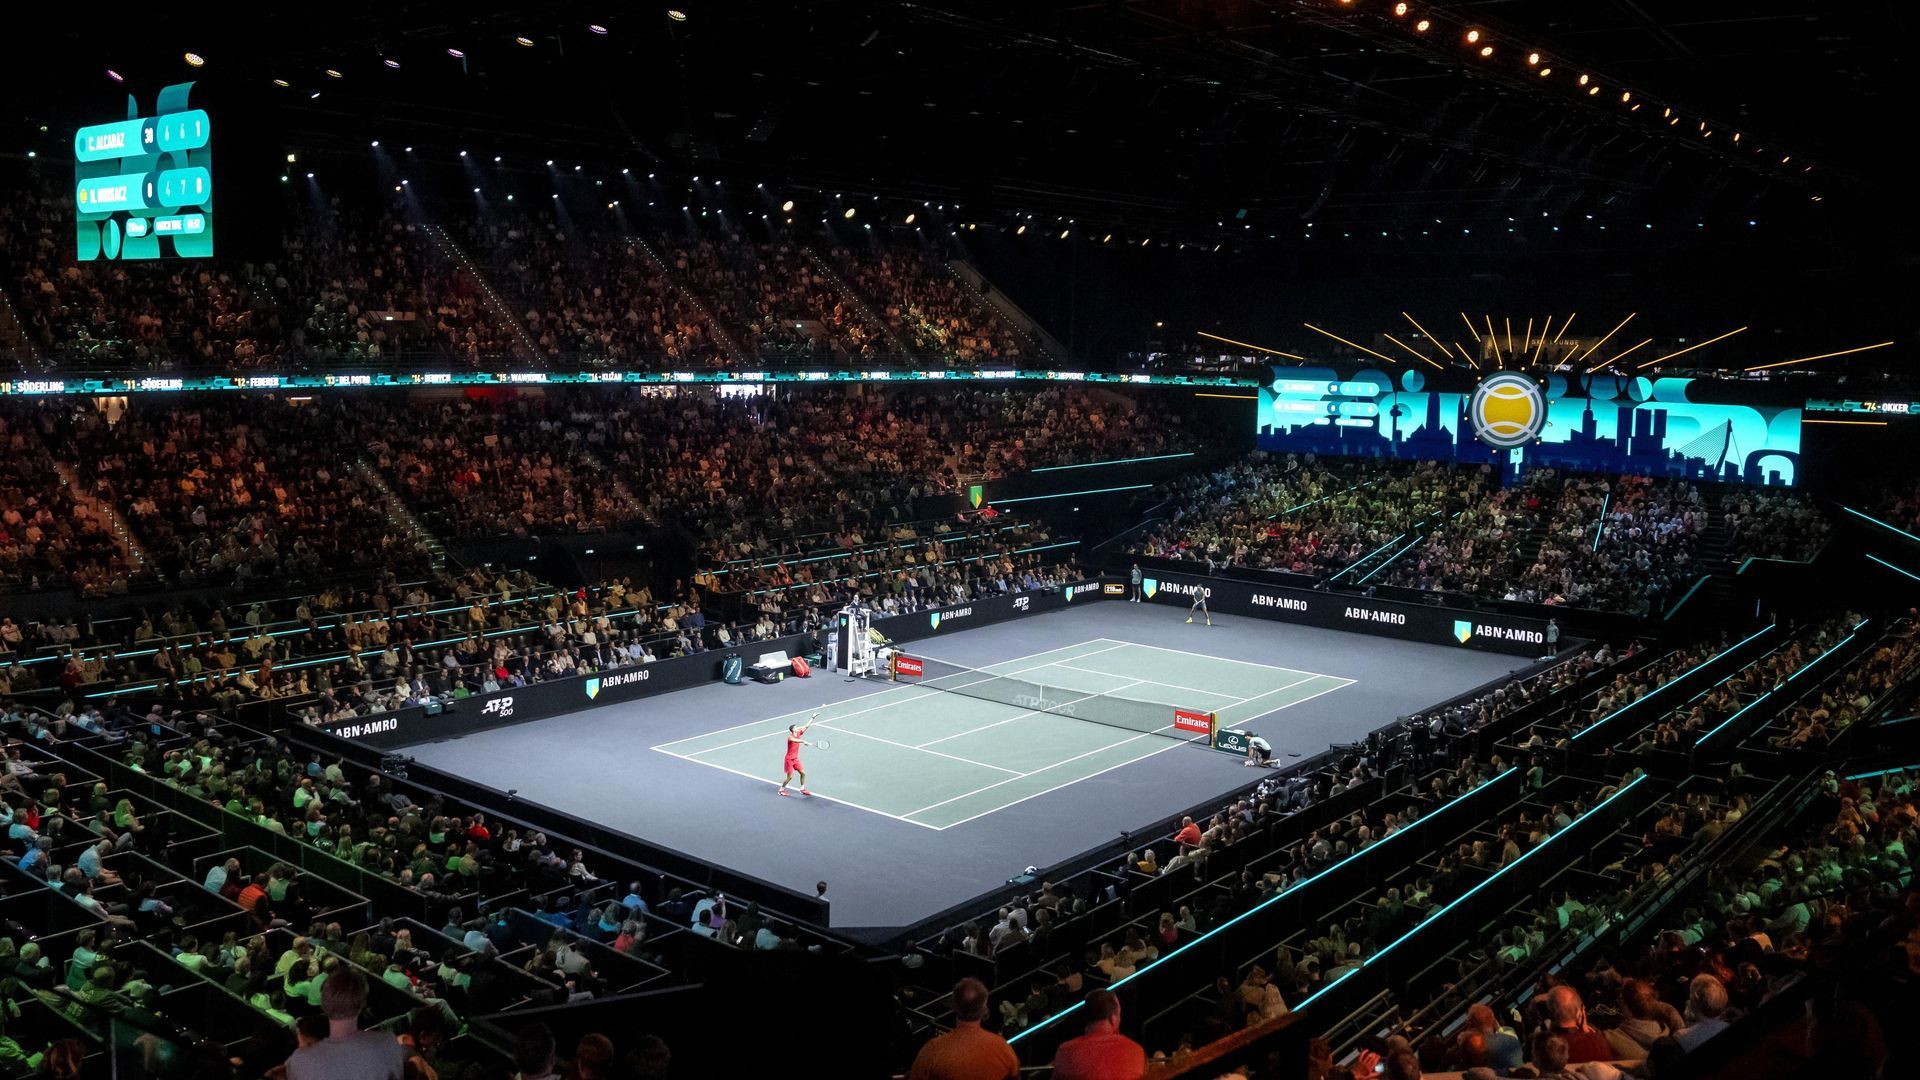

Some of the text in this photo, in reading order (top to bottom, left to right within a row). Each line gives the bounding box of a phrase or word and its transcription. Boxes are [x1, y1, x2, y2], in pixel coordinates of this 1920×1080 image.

[144, 128, 153, 144] 30
[164, 126, 170, 141] 6
[180, 123, 185, 139] 6
[196, 120, 200, 137] 1
[147, 182, 153, 198] 0
[166, 180, 170, 197] 4
[181, 179, 186, 195] 7
[17, 380, 64, 392] SÖDERLING
[1882, 403, 1908, 412] OKKER
[897, 660, 922, 672] Emirates
[480, 697, 513, 714] ATP
[499, 708, 513, 717] 500
[1177, 715, 1208, 729] Emirates
[1219, 742, 1247, 752] LEXUS
